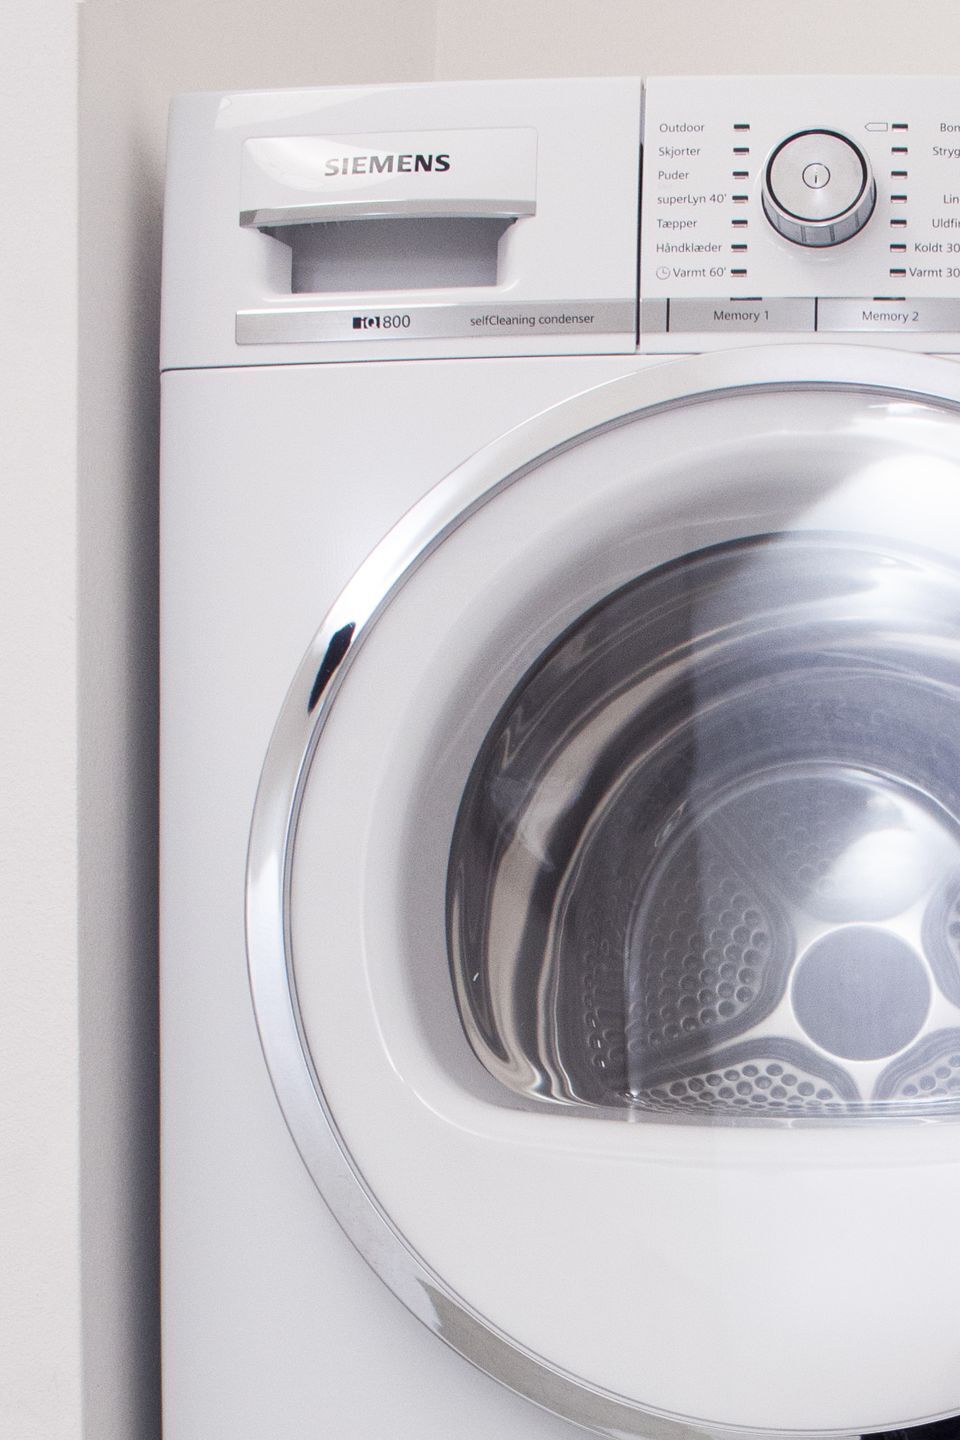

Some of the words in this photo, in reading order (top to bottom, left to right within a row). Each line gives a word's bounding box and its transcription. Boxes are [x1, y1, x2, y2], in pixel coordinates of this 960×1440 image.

[659, 122, 705, 134] Outdoor
[658, 146, 701, 158] Skjorter
[324, 153, 451, 177] SIEMENS
[657, 170, 690, 181] Puder
[657, 193, 707, 206] superLyn
[709, 193, 727, 205] 40'
[657, 218, 698, 230] Tæpper
[656, 241, 722, 254] Håndklæder
[914, 242, 943, 253] Koldt
[673, 266, 707, 278] Varmt
[709, 266, 727, 278] 60'
[909, 267, 944, 278] Varmt
[470, 314, 536, 328] selfCleaning
[538, 314, 595, 325] condenser
[713, 310, 759, 323] Memory
[763, 310, 770, 321] 1
[862, 310, 909, 323] Memory
[911, 311, 919, 322] 2
